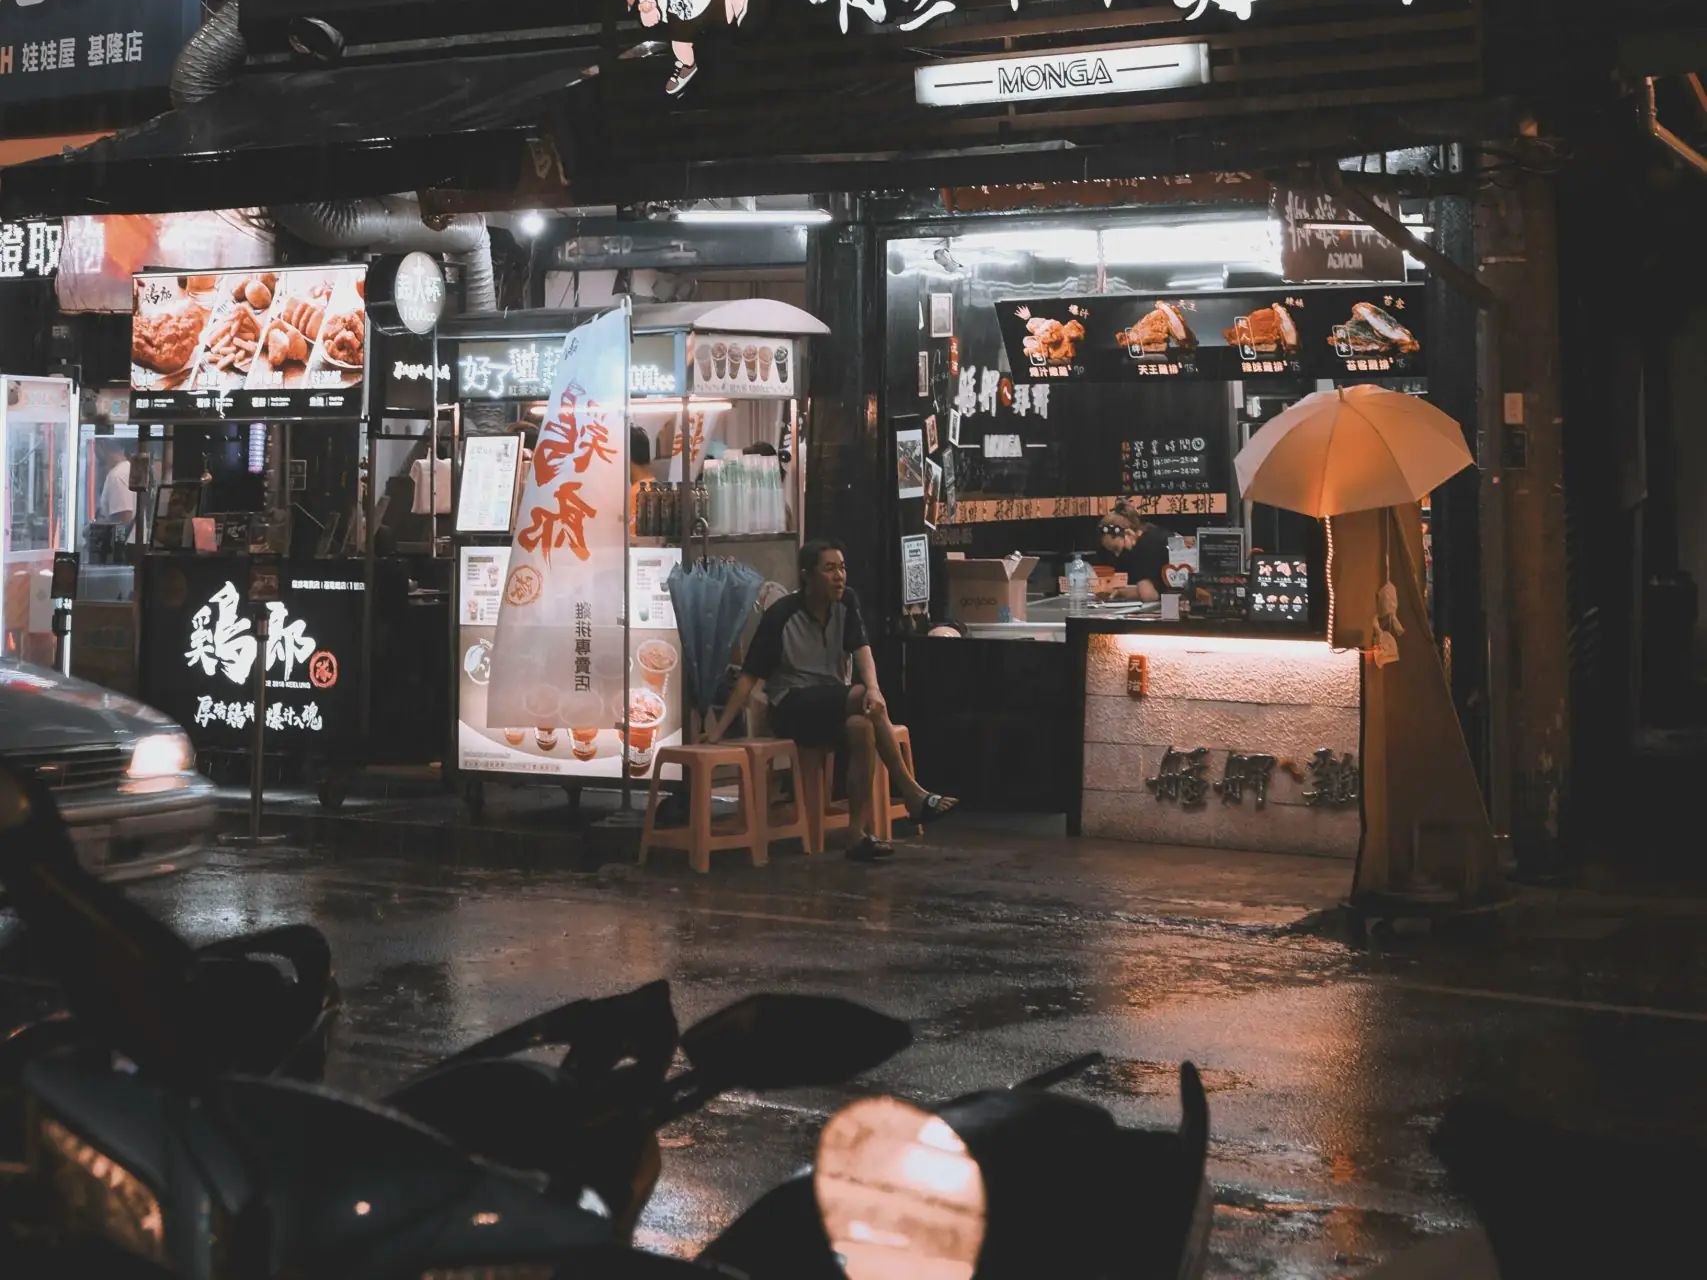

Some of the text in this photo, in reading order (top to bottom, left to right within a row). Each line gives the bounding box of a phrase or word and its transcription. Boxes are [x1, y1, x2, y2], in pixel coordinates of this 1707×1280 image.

[22, 37, 76, 72] 娃娃屋
[87, 29, 143, 67] 基隆店
[998, 56, 1114, 95] MONGA
[1109, 494, 1215, 514] 舺雞排
